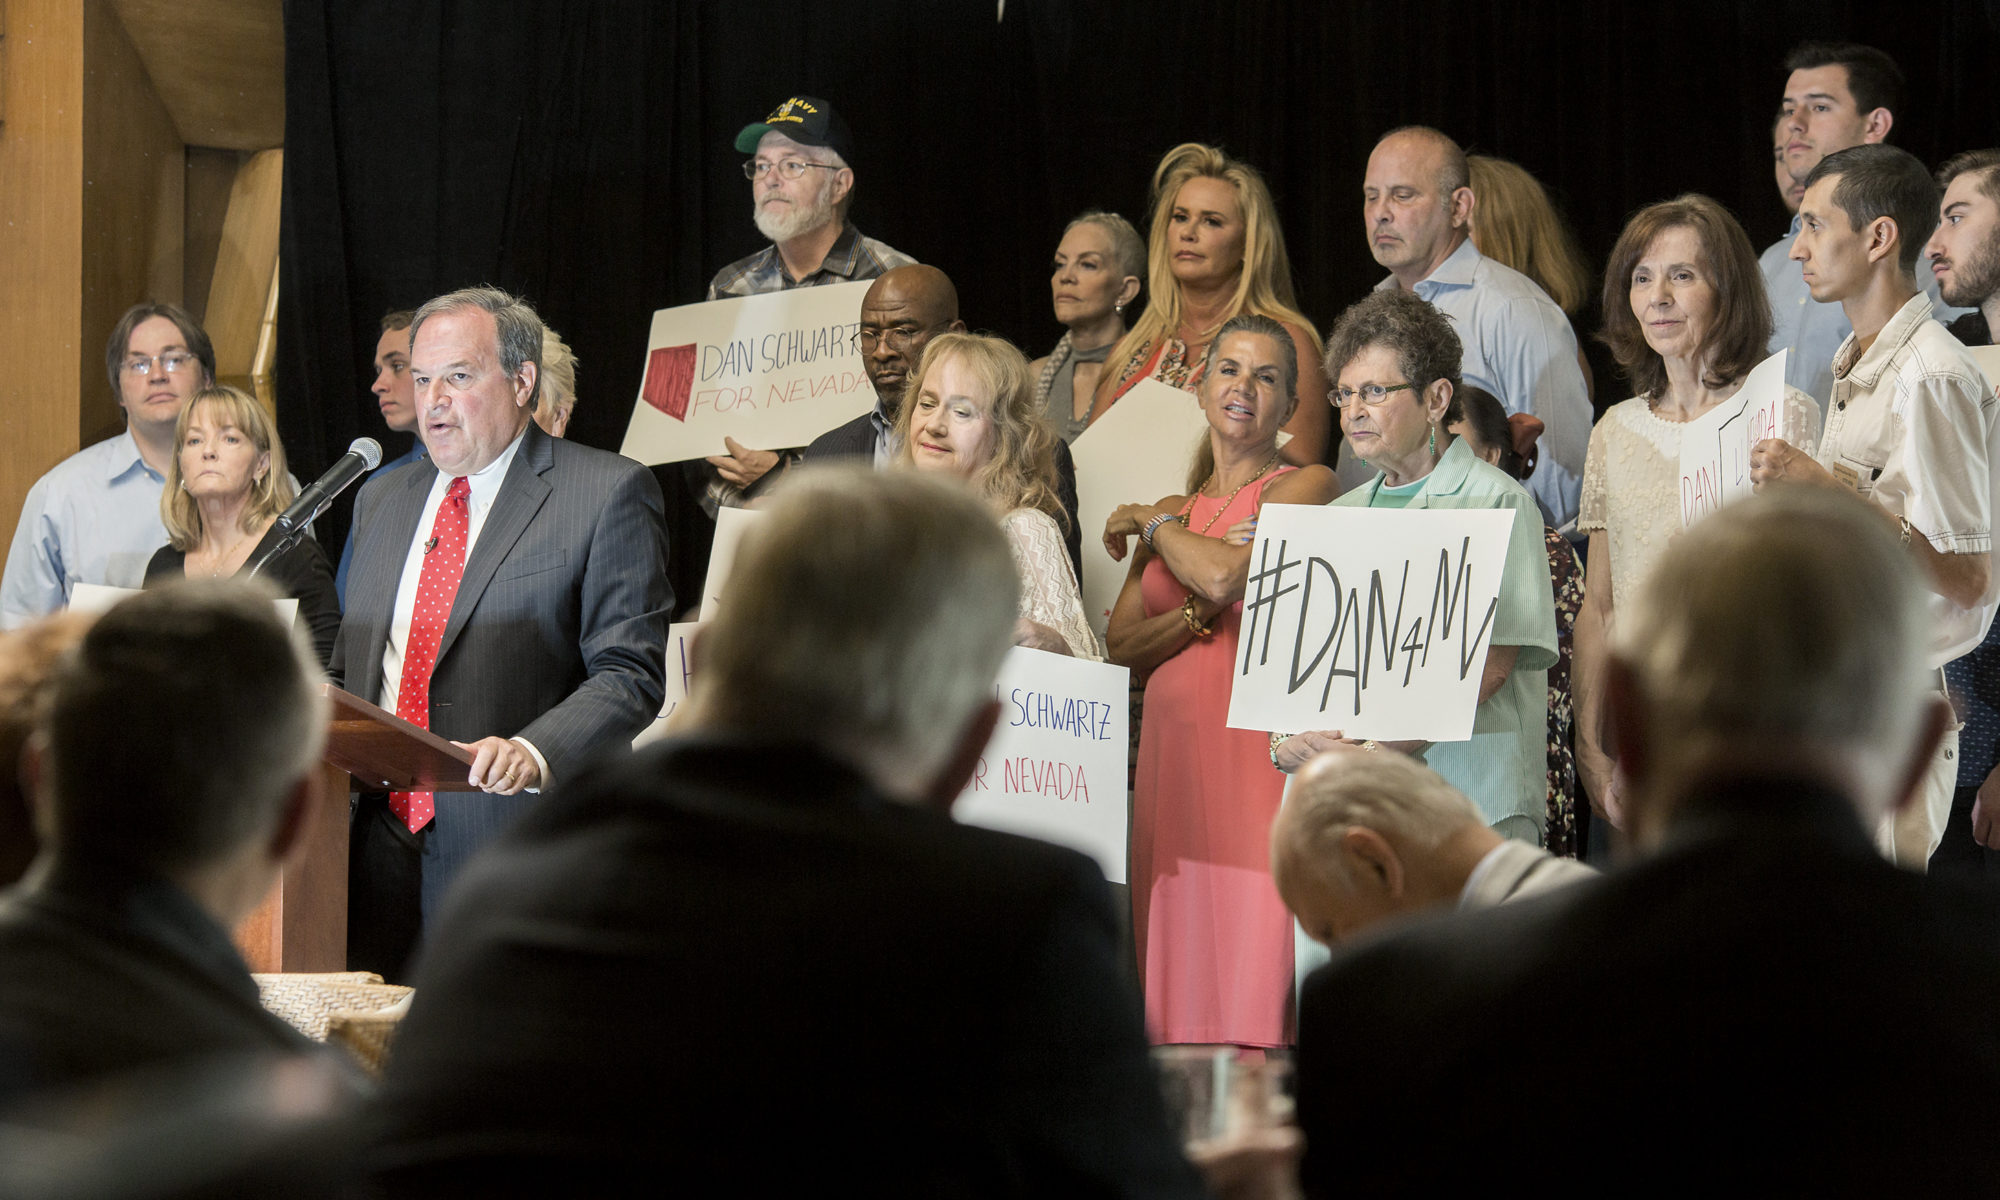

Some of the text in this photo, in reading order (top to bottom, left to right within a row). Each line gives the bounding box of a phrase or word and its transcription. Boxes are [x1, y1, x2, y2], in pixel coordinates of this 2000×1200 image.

[701, 322, 863, 382] DAN SCHWART
[692, 371, 871, 417] FOR NEVADA
[1683, 459, 1718, 528] DAN
[1010, 688, 1111, 740] SCHWARTZ
[1004, 757, 1090, 804] NEVADA
